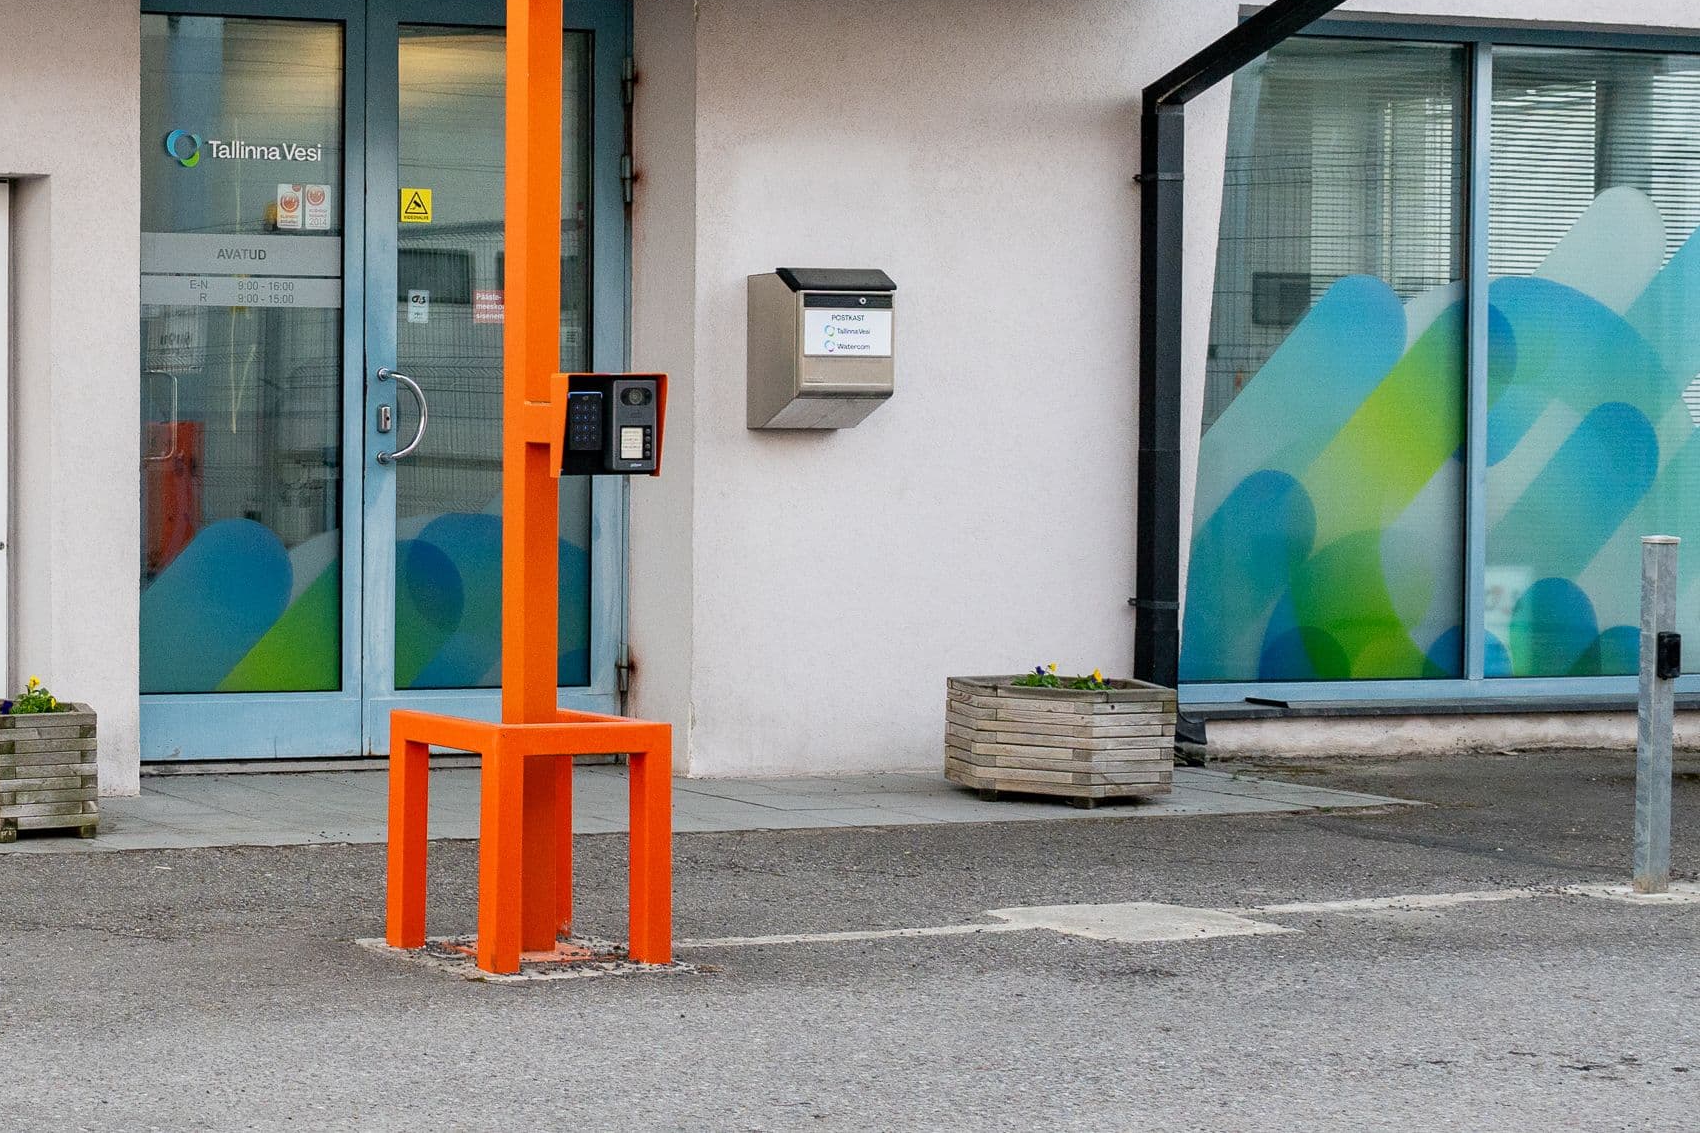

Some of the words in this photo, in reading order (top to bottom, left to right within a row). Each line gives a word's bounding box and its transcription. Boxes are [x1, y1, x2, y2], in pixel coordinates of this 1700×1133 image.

[207, 140, 281, 161] Tallinna
[282, 143, 322, 162] Vesi
[216, 248, 267, 261] AVATUD
[189, 279, 209, 291] E-N
[237, 280, 260, 291] 9:00
[268, 280, 295, 292] 16:00
[199, 292, 208, 303] R
[237, 293, 260, 304] 9:00
[268, 293, 295, 304] 15:00
[831, 314, 865, 322] POSTKAST
